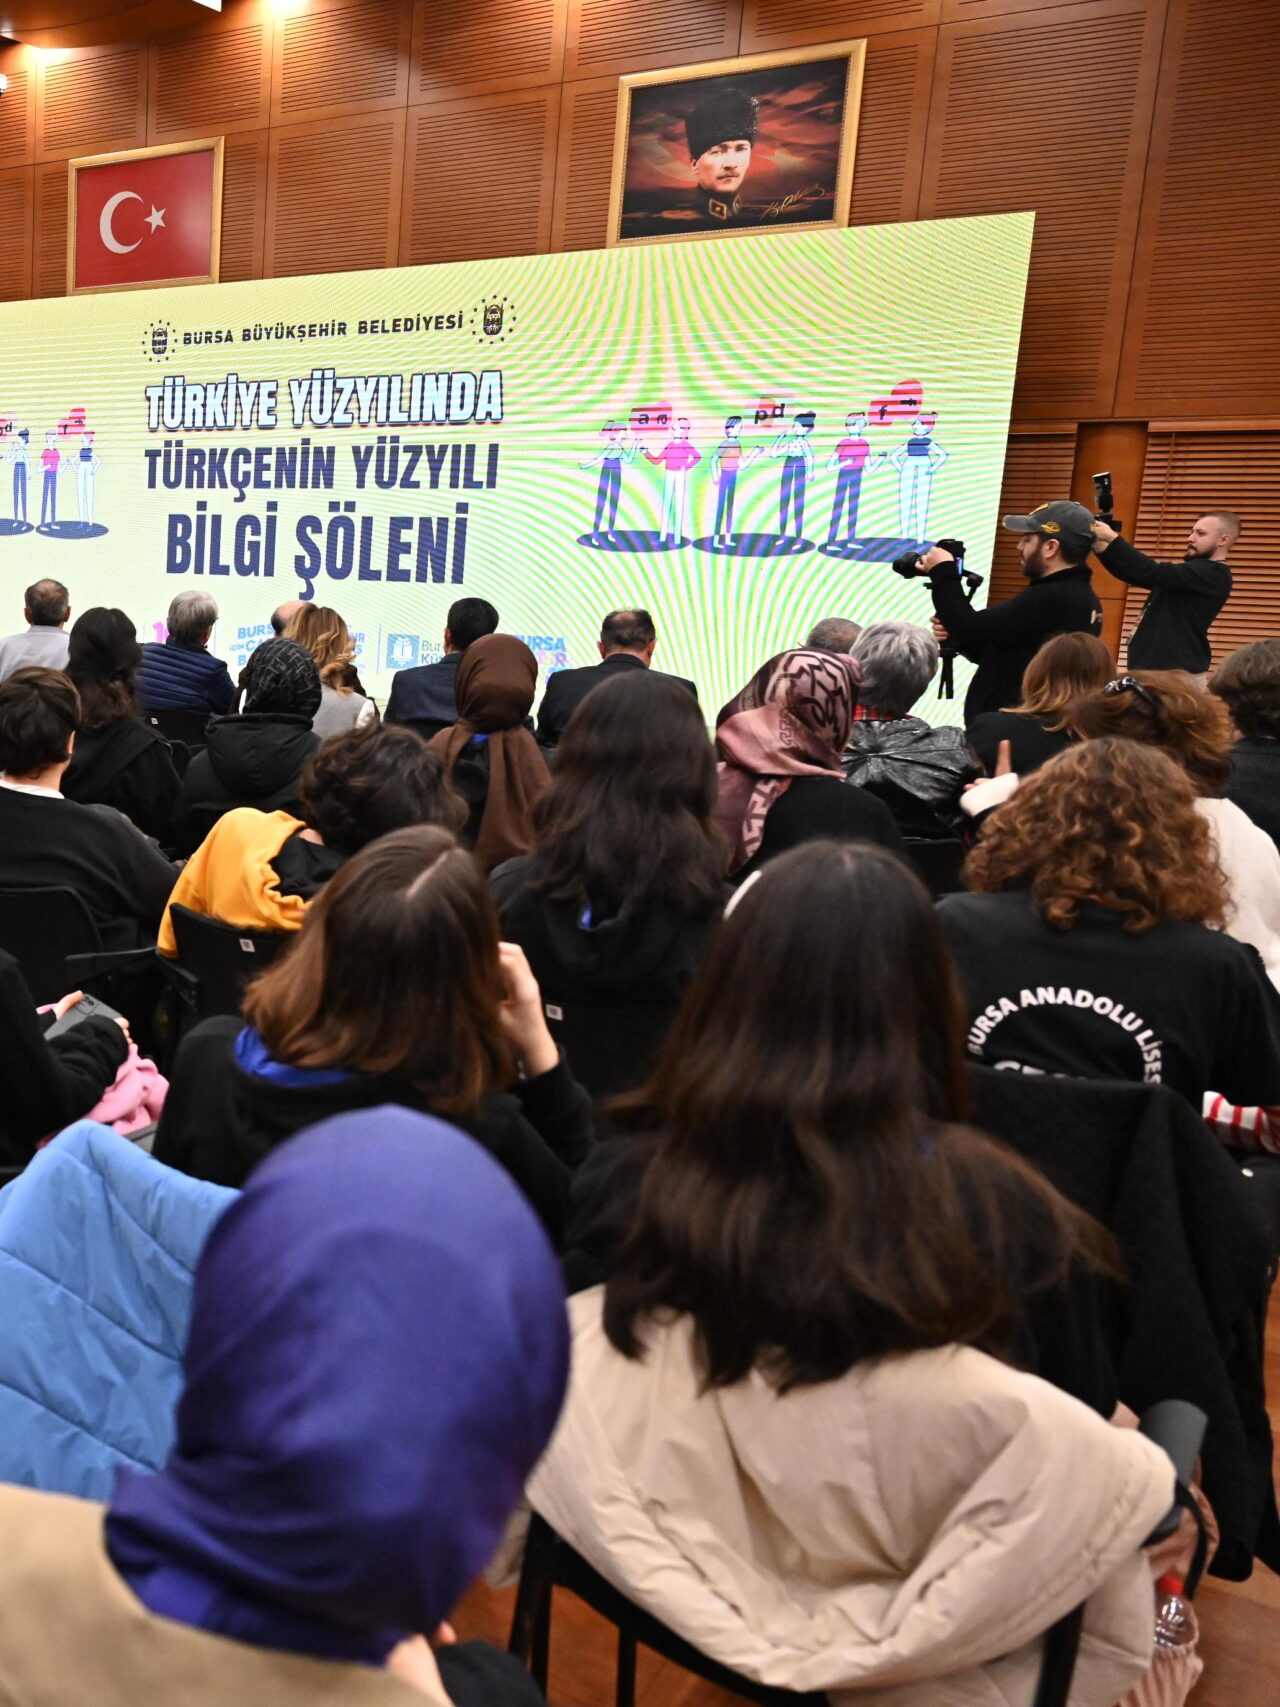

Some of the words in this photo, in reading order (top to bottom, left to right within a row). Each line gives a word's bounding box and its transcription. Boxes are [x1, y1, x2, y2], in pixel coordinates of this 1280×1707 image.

[182, 329, 234, 346] BURSA
[241, 318, 348, 343] BÜYÜKŞEHİR
[358, 311, 465, 335] BELEDİYESİ
[144, 373, 279, 431] TÜRKİYE
[288, 367, 504, 429] YÜZYILINDA
[144, 437, 336, 502] TÜRKÇENİN
[352, 435, 500, 490] YÜZYILI
[166, 500, 278, 578] BİLGİ
[294, 501, 470, 600] ŞÖLENİ
[237, 623, 275, 640] BURS
[1020, 986, 1143, 1032] ANADOLU
